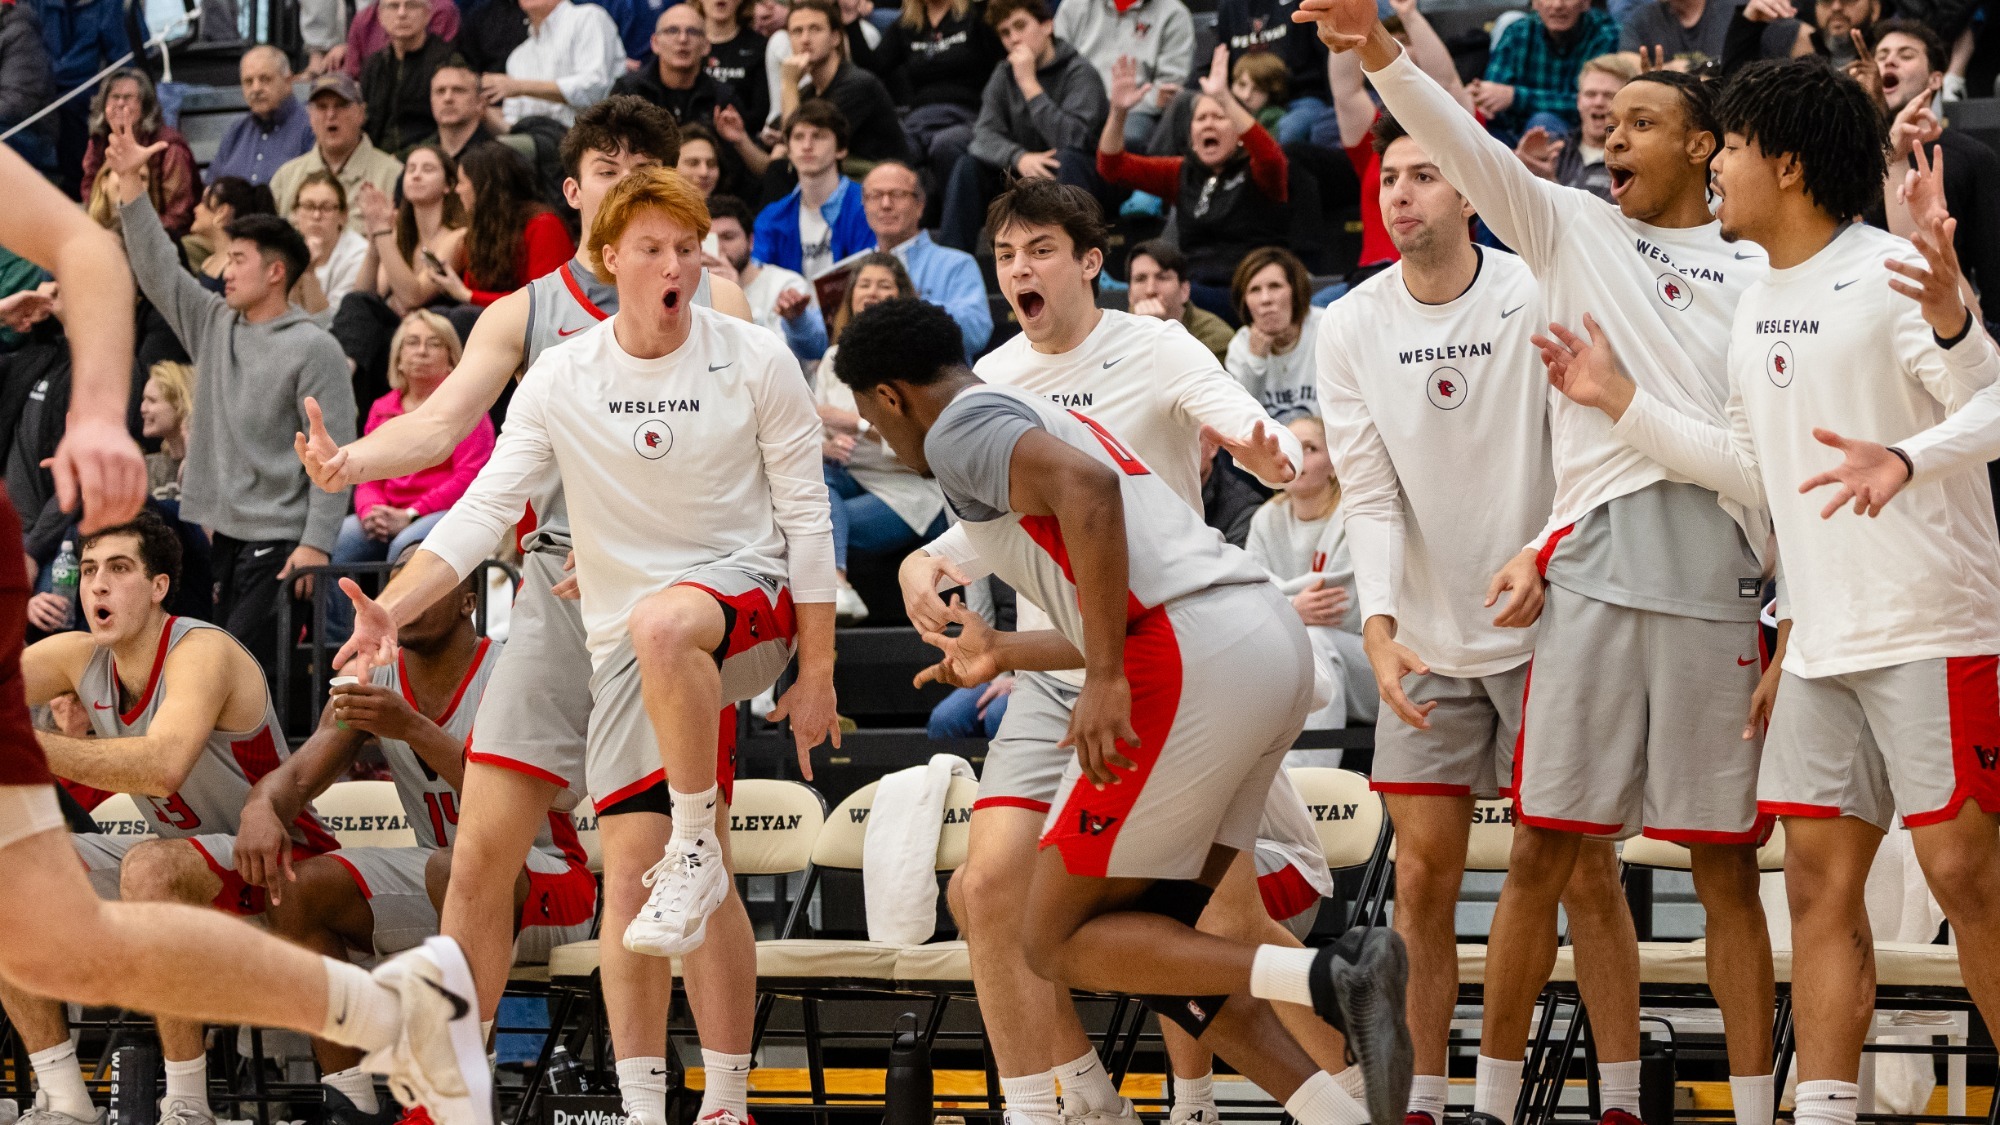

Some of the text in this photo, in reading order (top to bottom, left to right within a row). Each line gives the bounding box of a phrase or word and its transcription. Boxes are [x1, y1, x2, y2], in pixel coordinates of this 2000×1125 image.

[1756, 319, 1820, 335] WESLEYAN
[1399, 342, 1492, 364] WESLEYAN
[608, 399, 700, 414] WESLEYAN
[1051, 393, 1093, 407] EYAN
[1308, 804, 1359, 822] YAN
[97, 820, 156, 835] WES
[110, 1051, 121, 1125] WESLE
